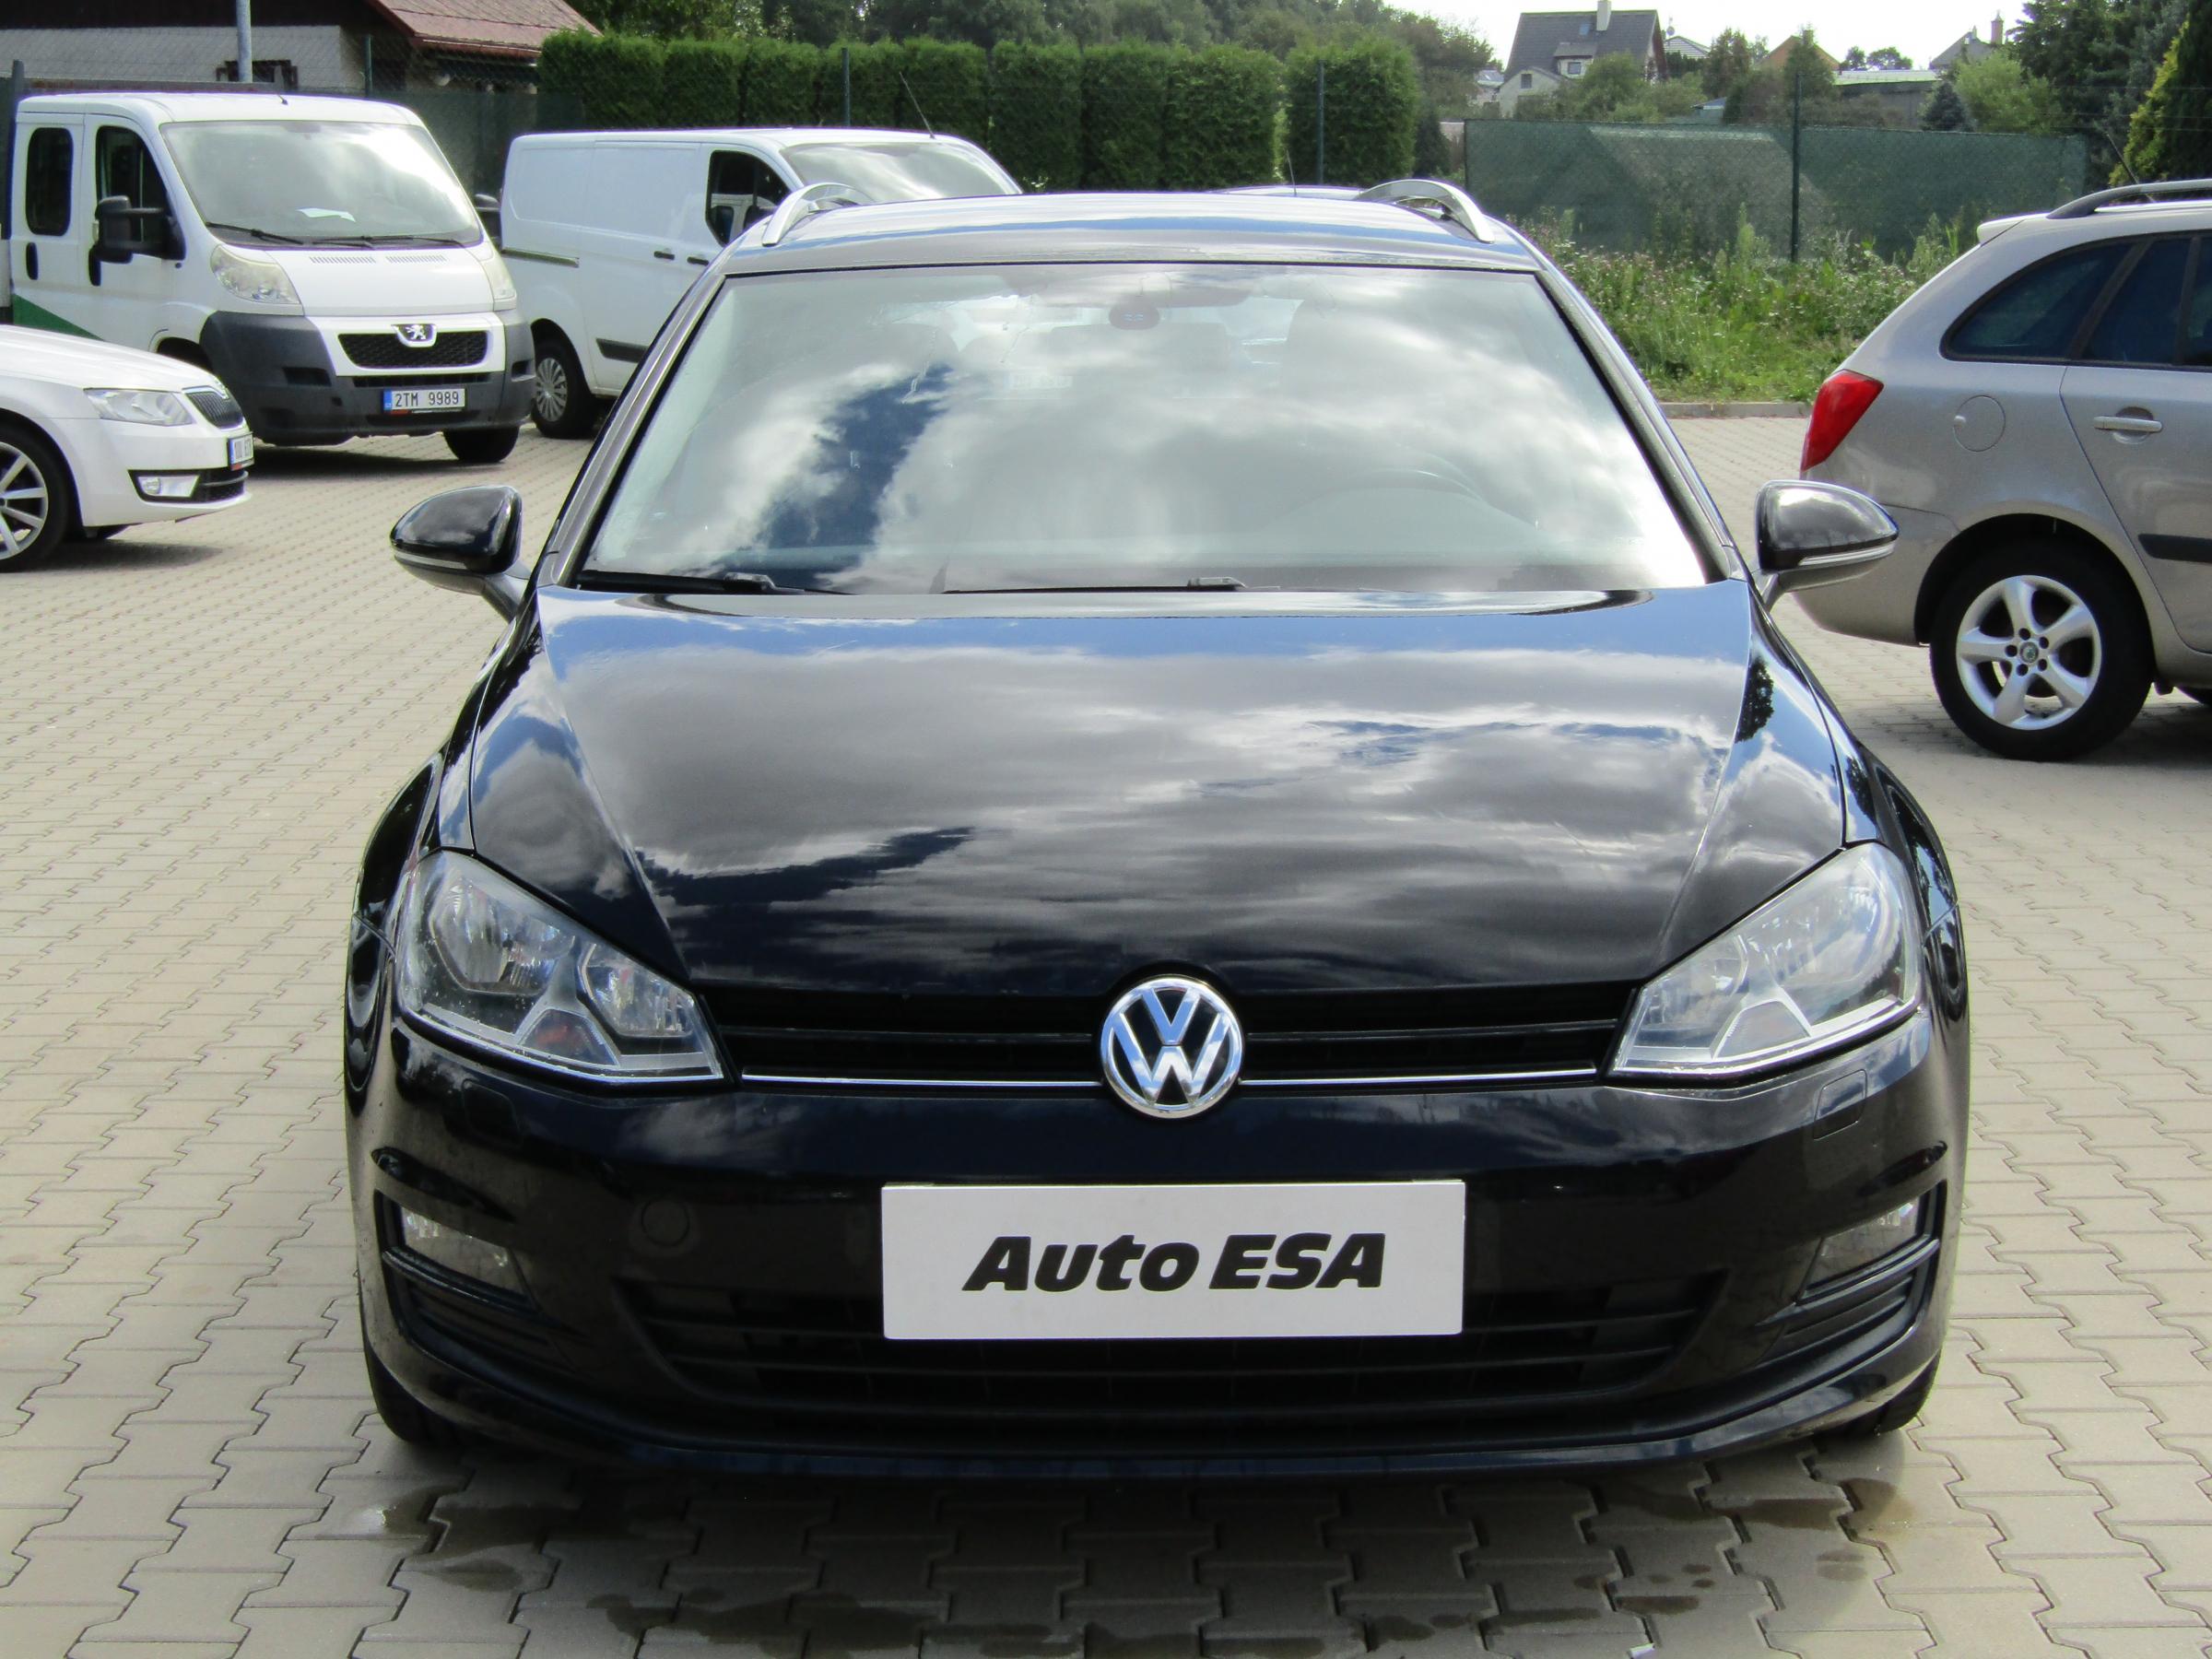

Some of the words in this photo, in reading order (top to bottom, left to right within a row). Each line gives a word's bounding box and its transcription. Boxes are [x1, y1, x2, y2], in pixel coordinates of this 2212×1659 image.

[394, 393, 418, 407] 2TM
[428, 391, 459, 406] 9989
[1106, 982, 1237, 1110] VW
[961, 1234, 1200, 1293] Auto
[1208, 1232, 1386, 1290] ESA
